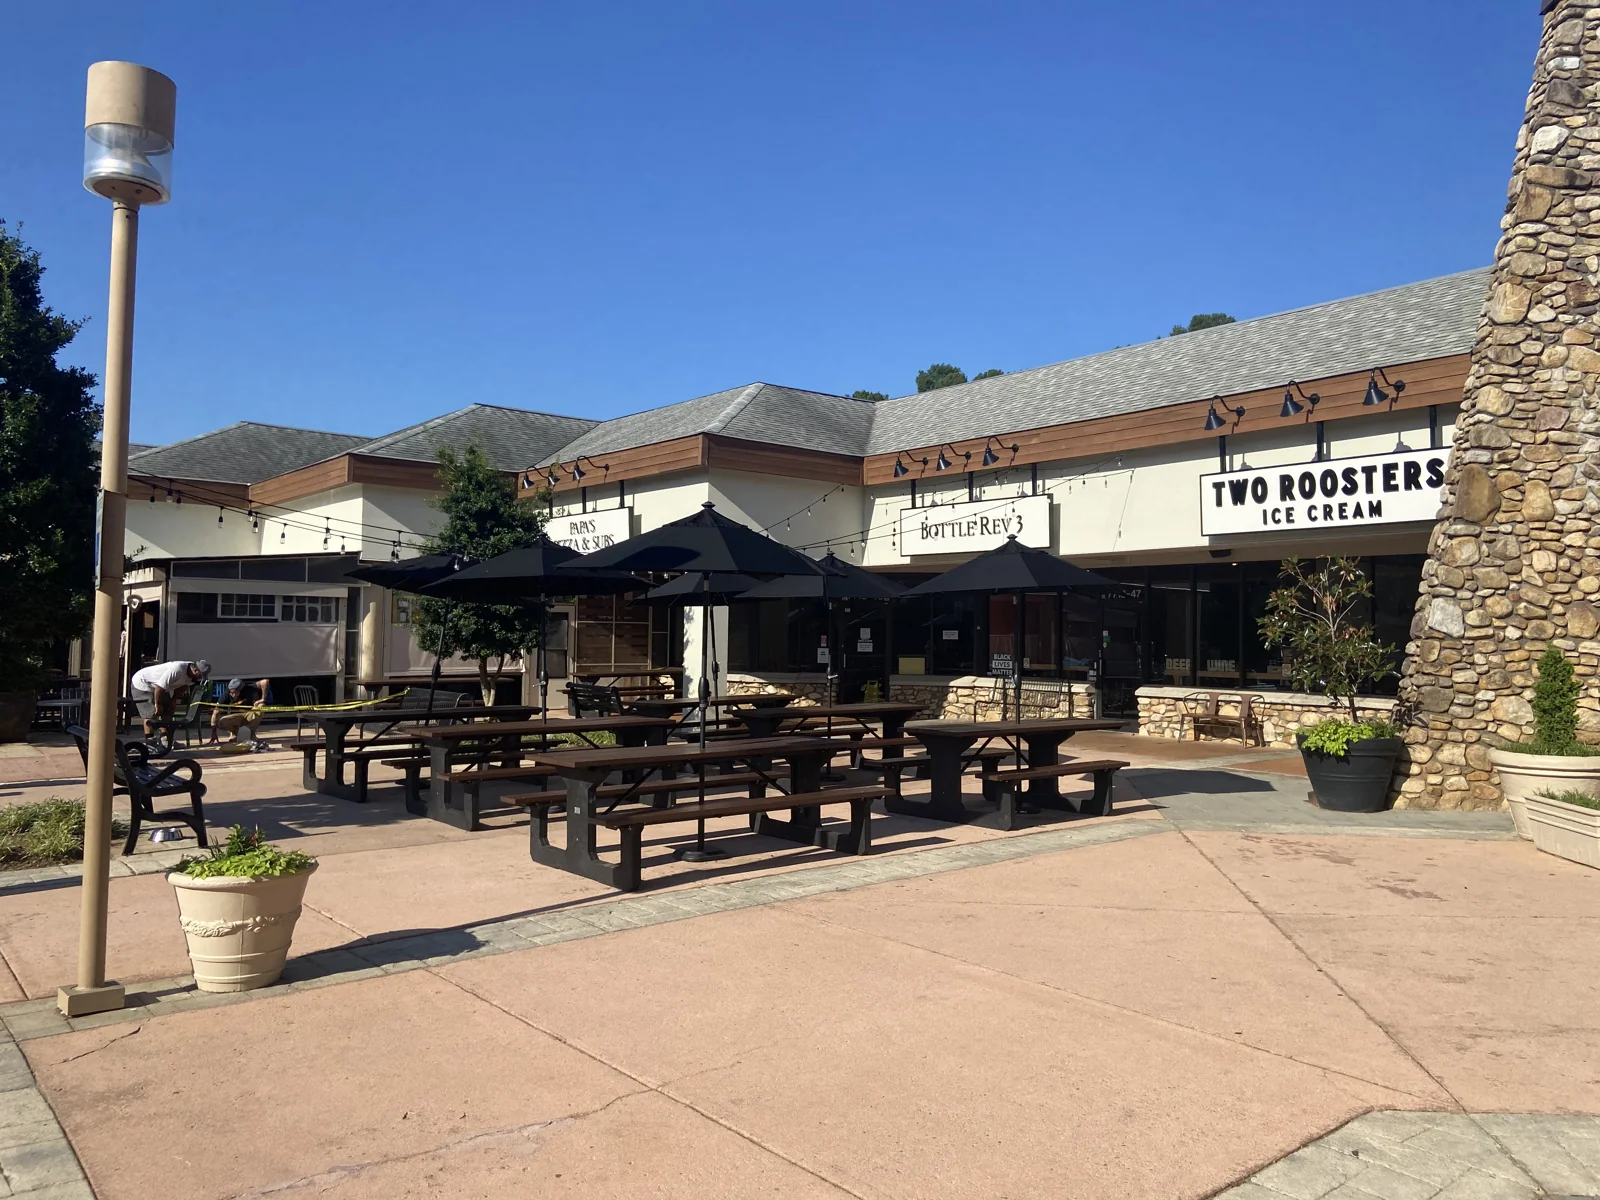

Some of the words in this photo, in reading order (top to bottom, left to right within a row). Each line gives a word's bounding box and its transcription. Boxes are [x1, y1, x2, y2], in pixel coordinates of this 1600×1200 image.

[1212, 476, 1268, 507] TWO
[1279, 458, 1445, 501] ROOSTERS
[1262, 507, 1295, 526] ICE
[1307, 500, 1383, 522] CREAM
[569, 519, 596, 535] PAPA'S
[1016, 514, 1024, 535] 3
[582, 537, 590, 551] &
[592, 534, 615, 550] SUBS
[1206, 659, 1236, 672] WINE
